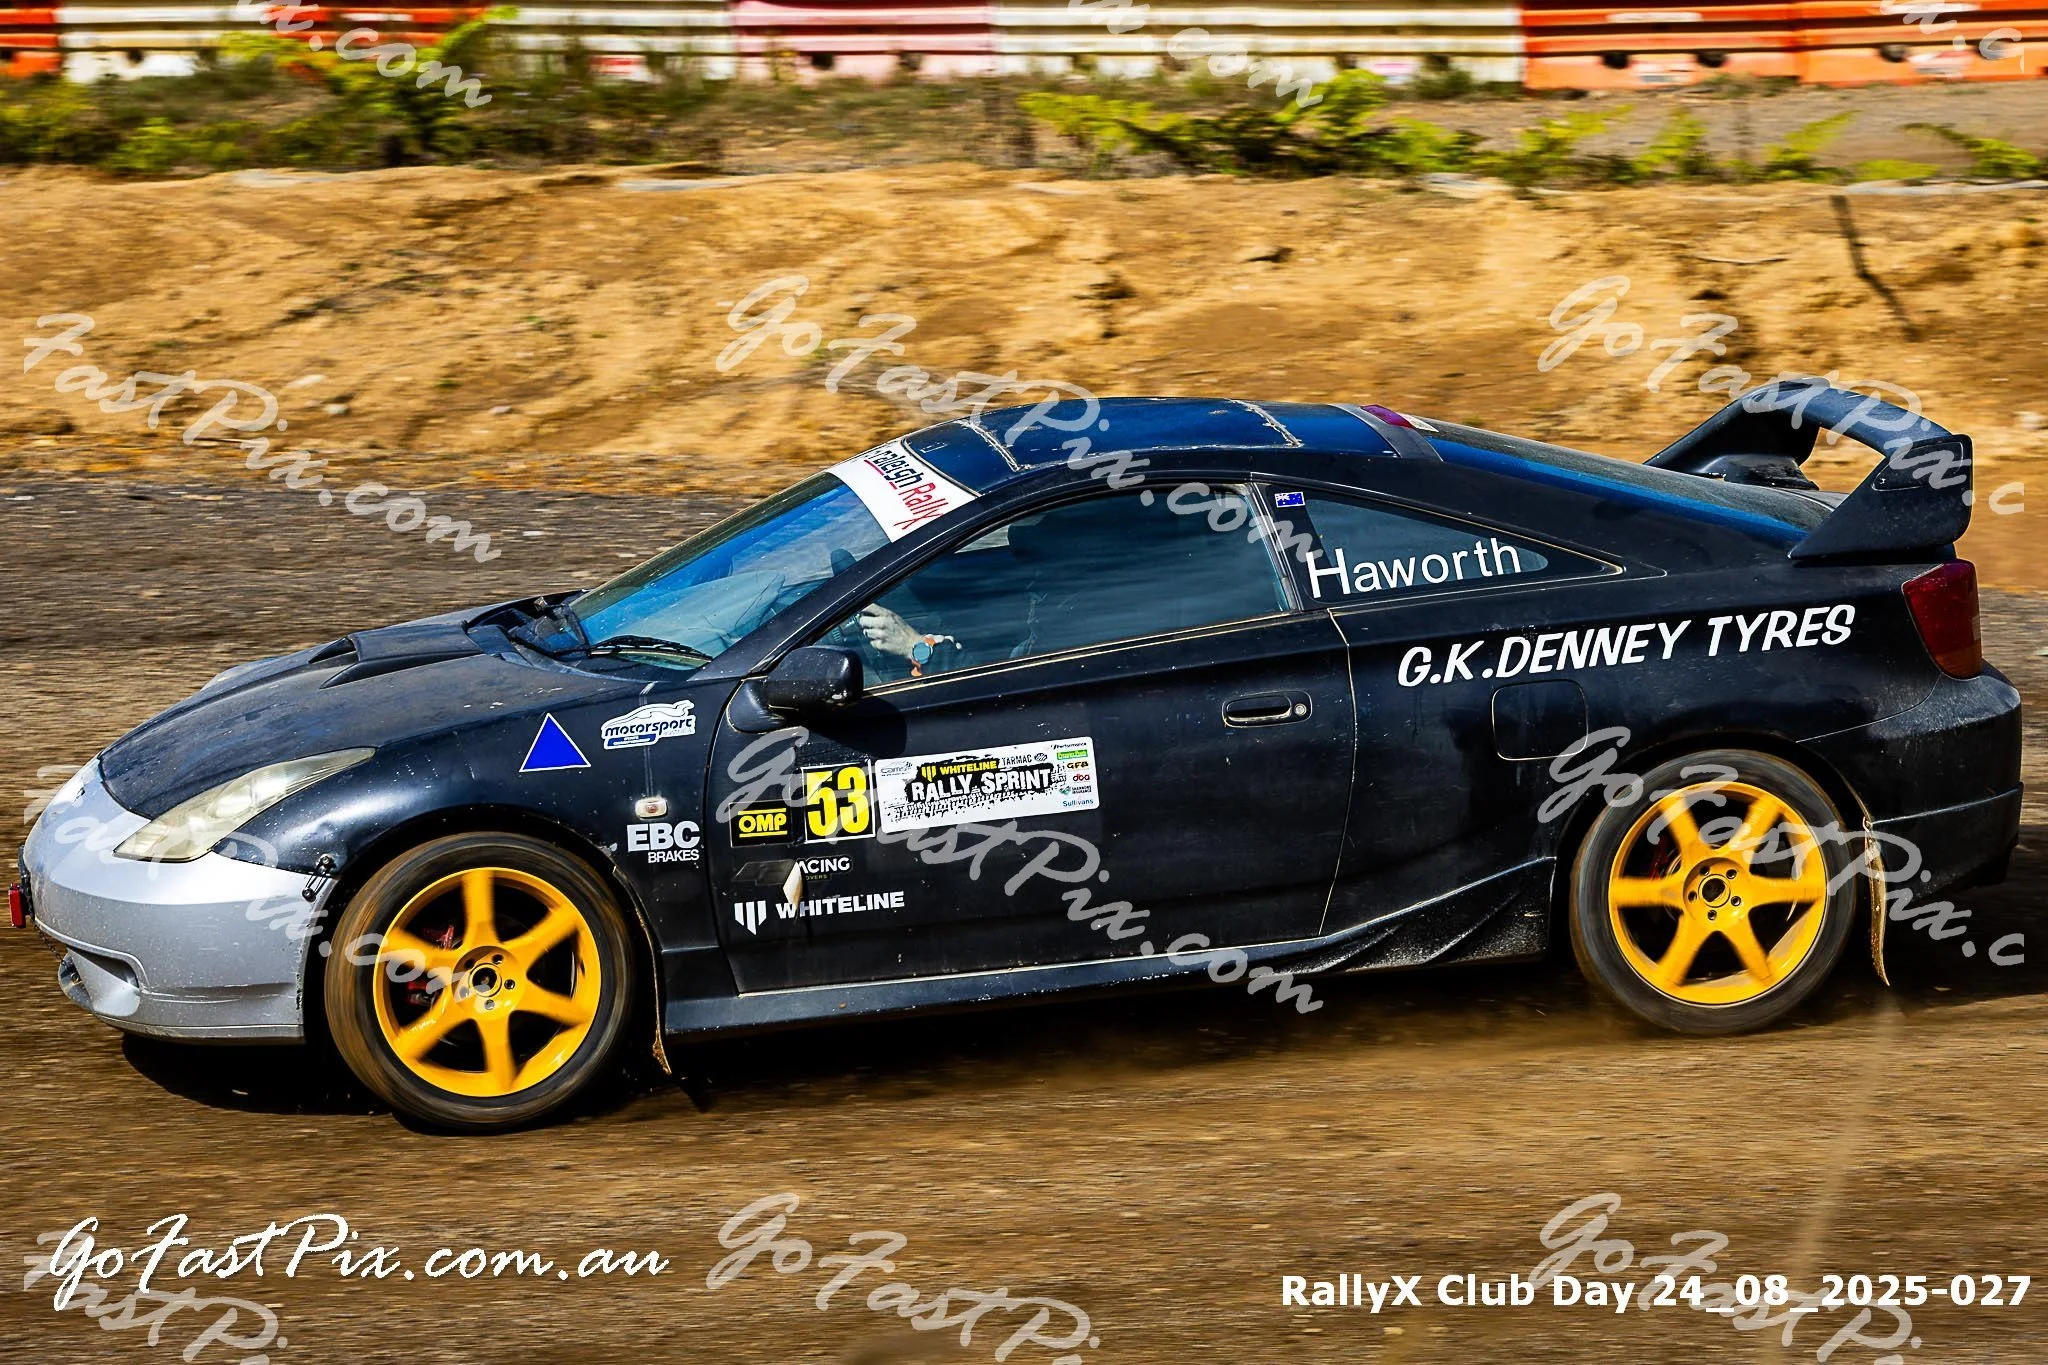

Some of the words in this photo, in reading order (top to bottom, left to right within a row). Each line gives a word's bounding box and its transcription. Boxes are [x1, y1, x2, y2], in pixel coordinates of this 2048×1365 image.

[1306, 536, 1522, 599] Haworth
[1708, 604, 1856, 657] TYRES
[605, 718, 693, 736] motorsport
[939, 760, 998, 776] WHITELINE
[1001, 754, 1033, 766] TARMAC
[911, 774, 975, 802] RALLY
[981, 769, 1052, 795] SPRINT
[806, 766, 870, 837] 53
[1062, 799, 1094, 807] Sullivans
[738, 813, 788, 833] OMP
[626, 820, 700, 852] EBC
[648, 849, 700, 863] BRAKES
[797, 856, 851, 874] ACING
[775, 890, 905, 919] WHITELINE
